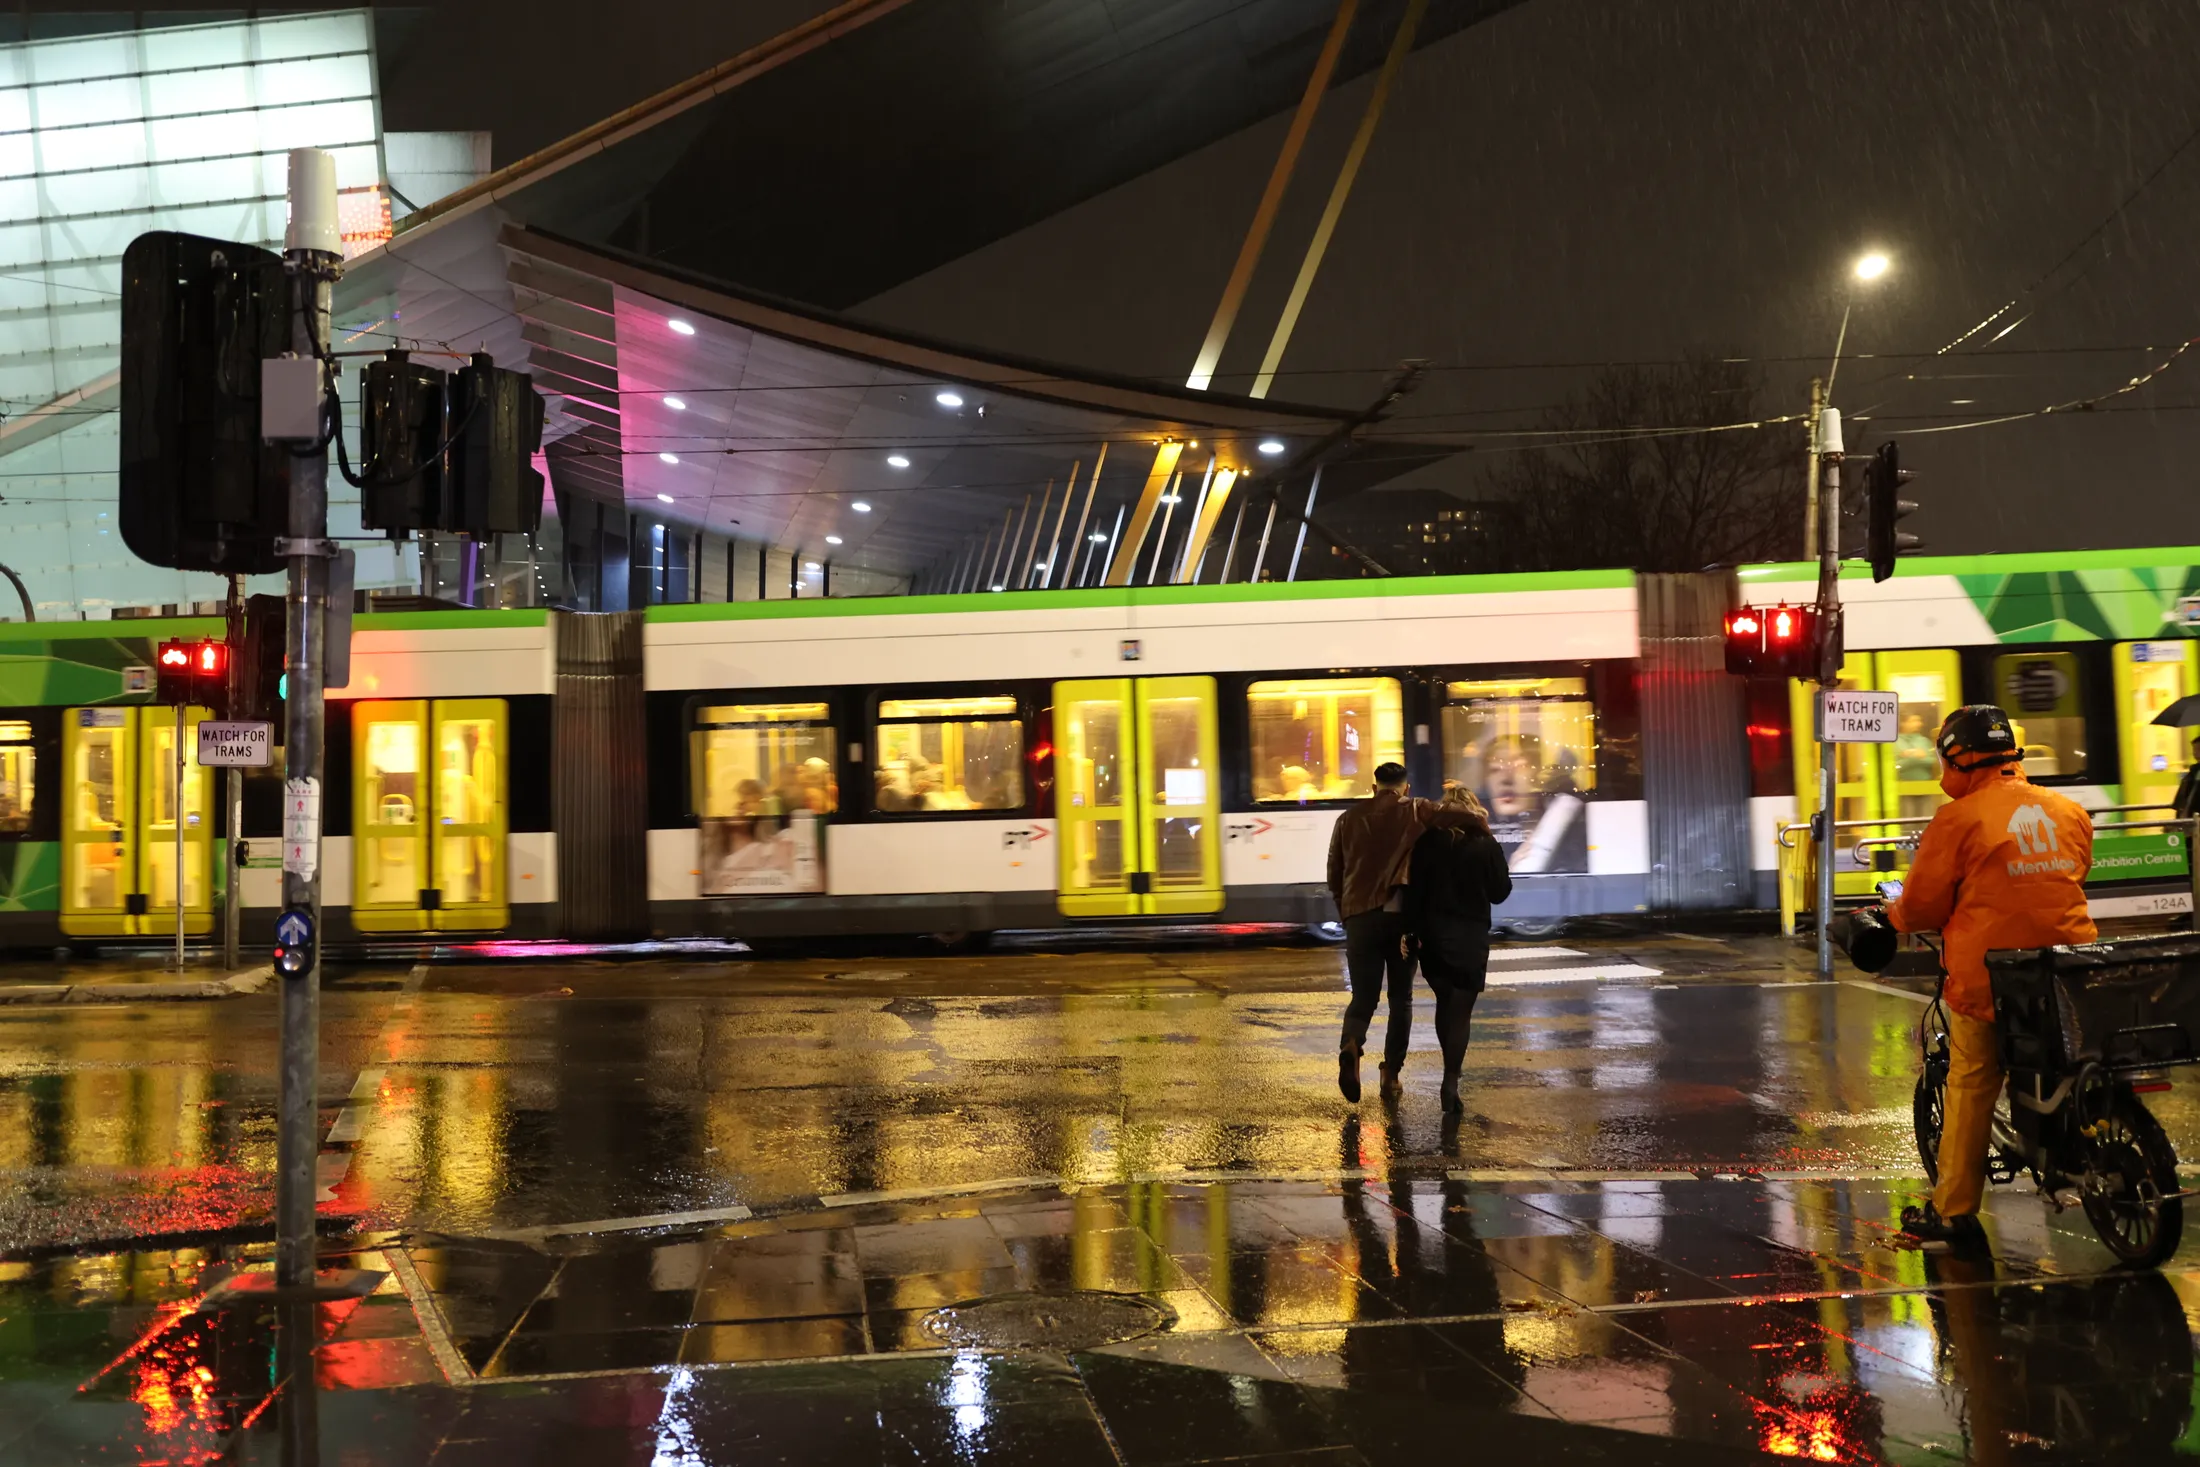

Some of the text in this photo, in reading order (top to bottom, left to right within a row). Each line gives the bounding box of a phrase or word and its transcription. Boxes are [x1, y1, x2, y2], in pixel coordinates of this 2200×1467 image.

[1828, 701, 1894, 714] WATCH FOR
[1841, 718, 1881, 731] TRAMS
[202, 730, 265, 741] WATCH FOR
[214, 746, 252, 757] TRAMS
[2091, 853, 2182, 868] Exhibition Centre
[2153, 897, 2187, 909] 124A
